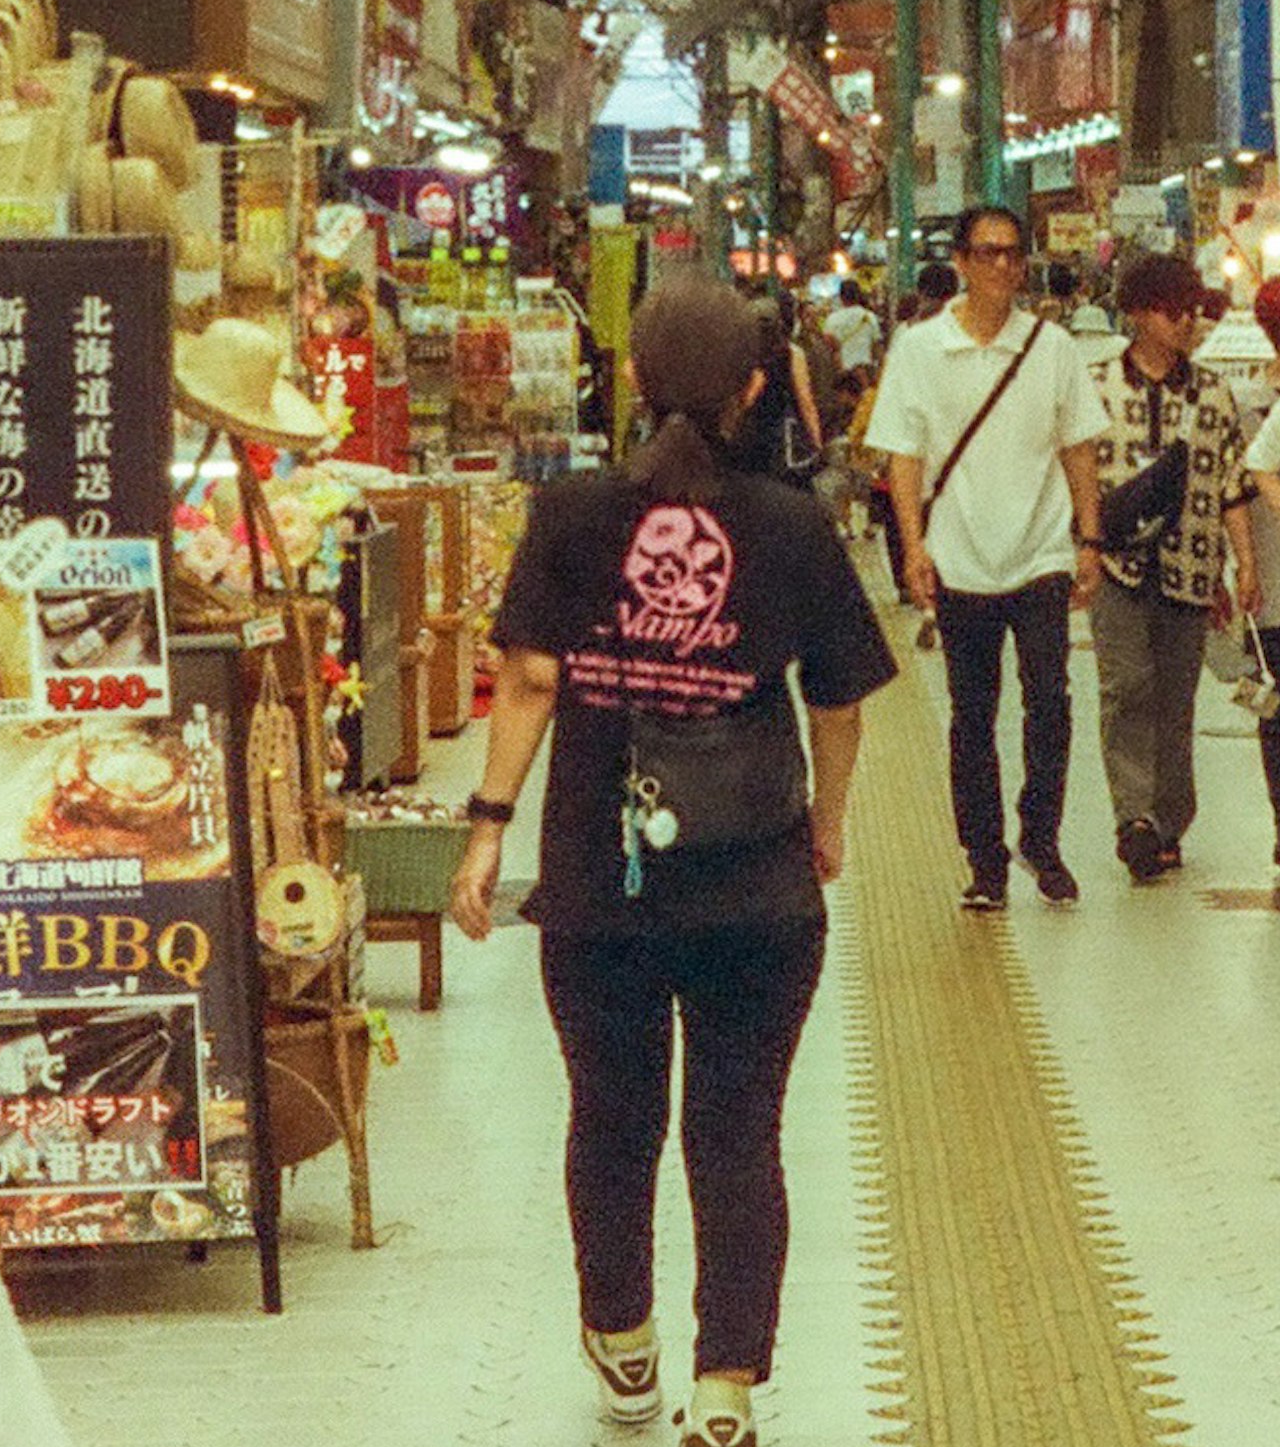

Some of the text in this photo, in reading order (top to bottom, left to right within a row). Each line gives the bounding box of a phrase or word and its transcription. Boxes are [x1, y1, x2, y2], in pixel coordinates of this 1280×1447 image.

[73, 295, 113, 539] 北海道直送の
